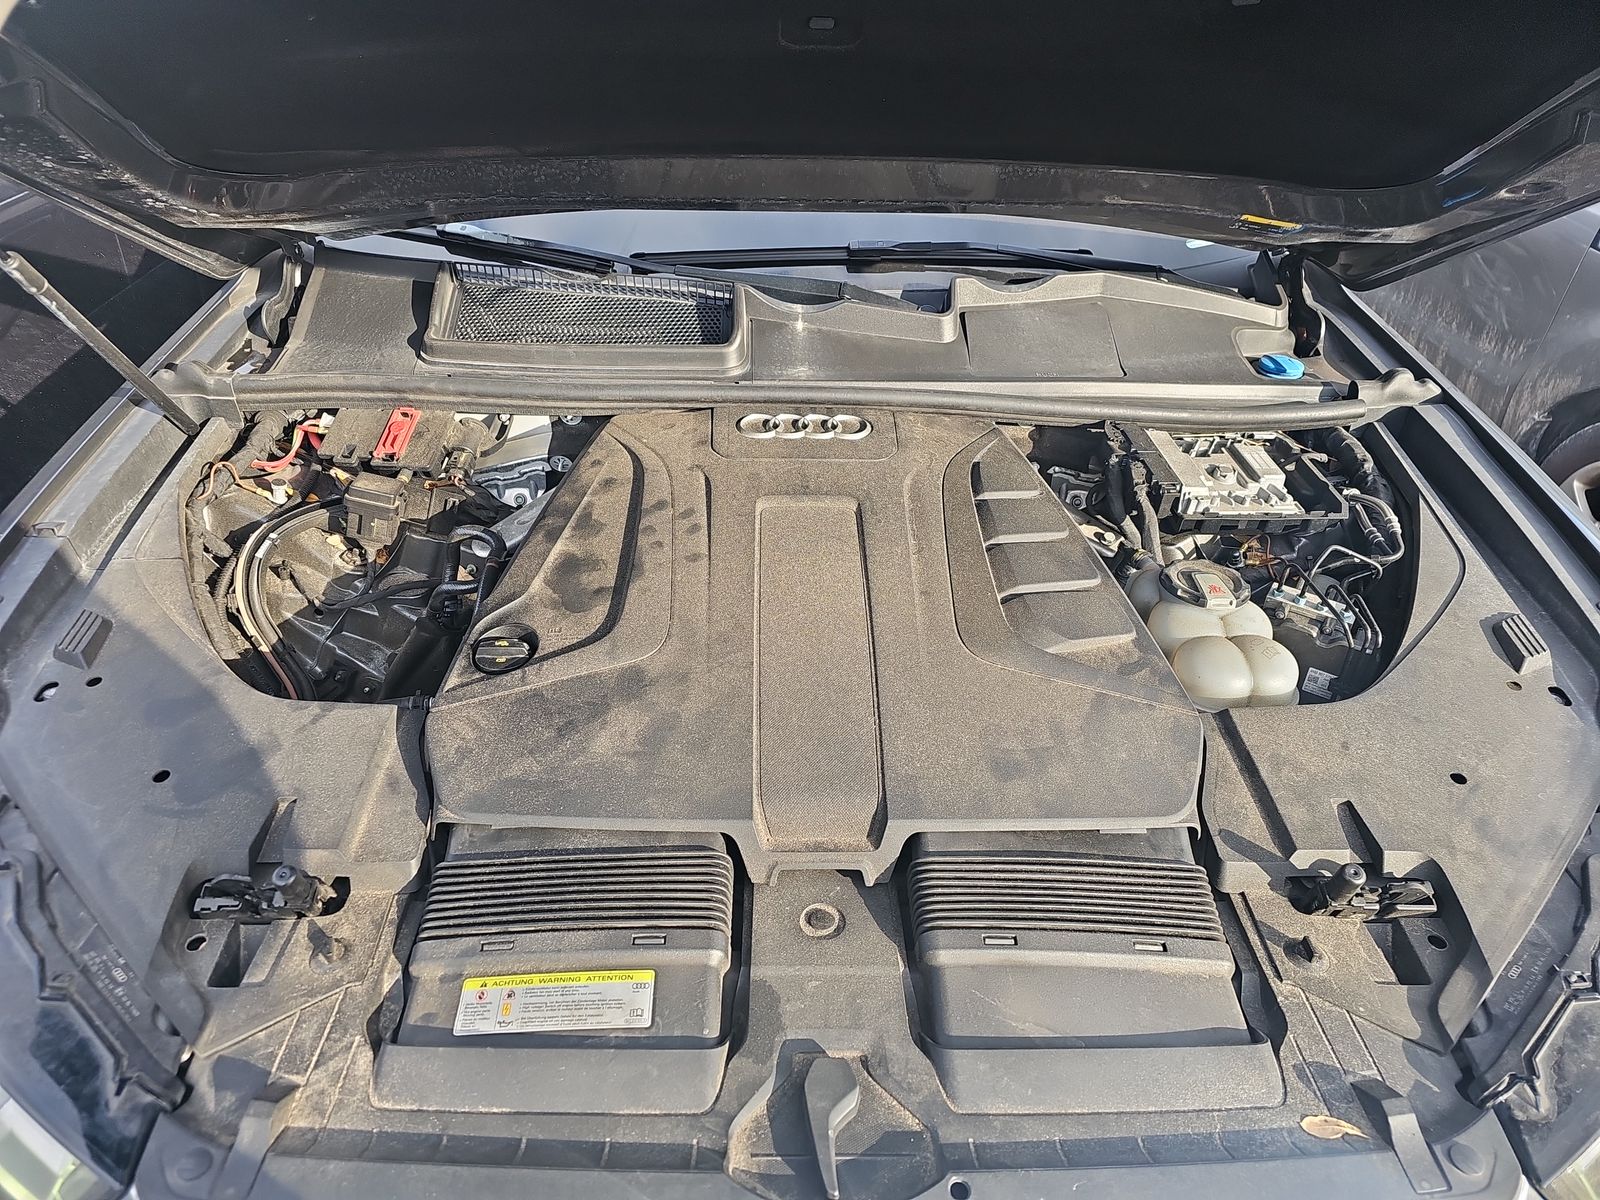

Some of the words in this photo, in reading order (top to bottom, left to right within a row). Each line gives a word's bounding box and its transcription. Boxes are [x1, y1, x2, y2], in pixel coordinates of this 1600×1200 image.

[491, 978, 534, 987] ACHTUNG
[538, 976, 581, 985] WARNING
[585, 974, 634, 982] ATTENTION
